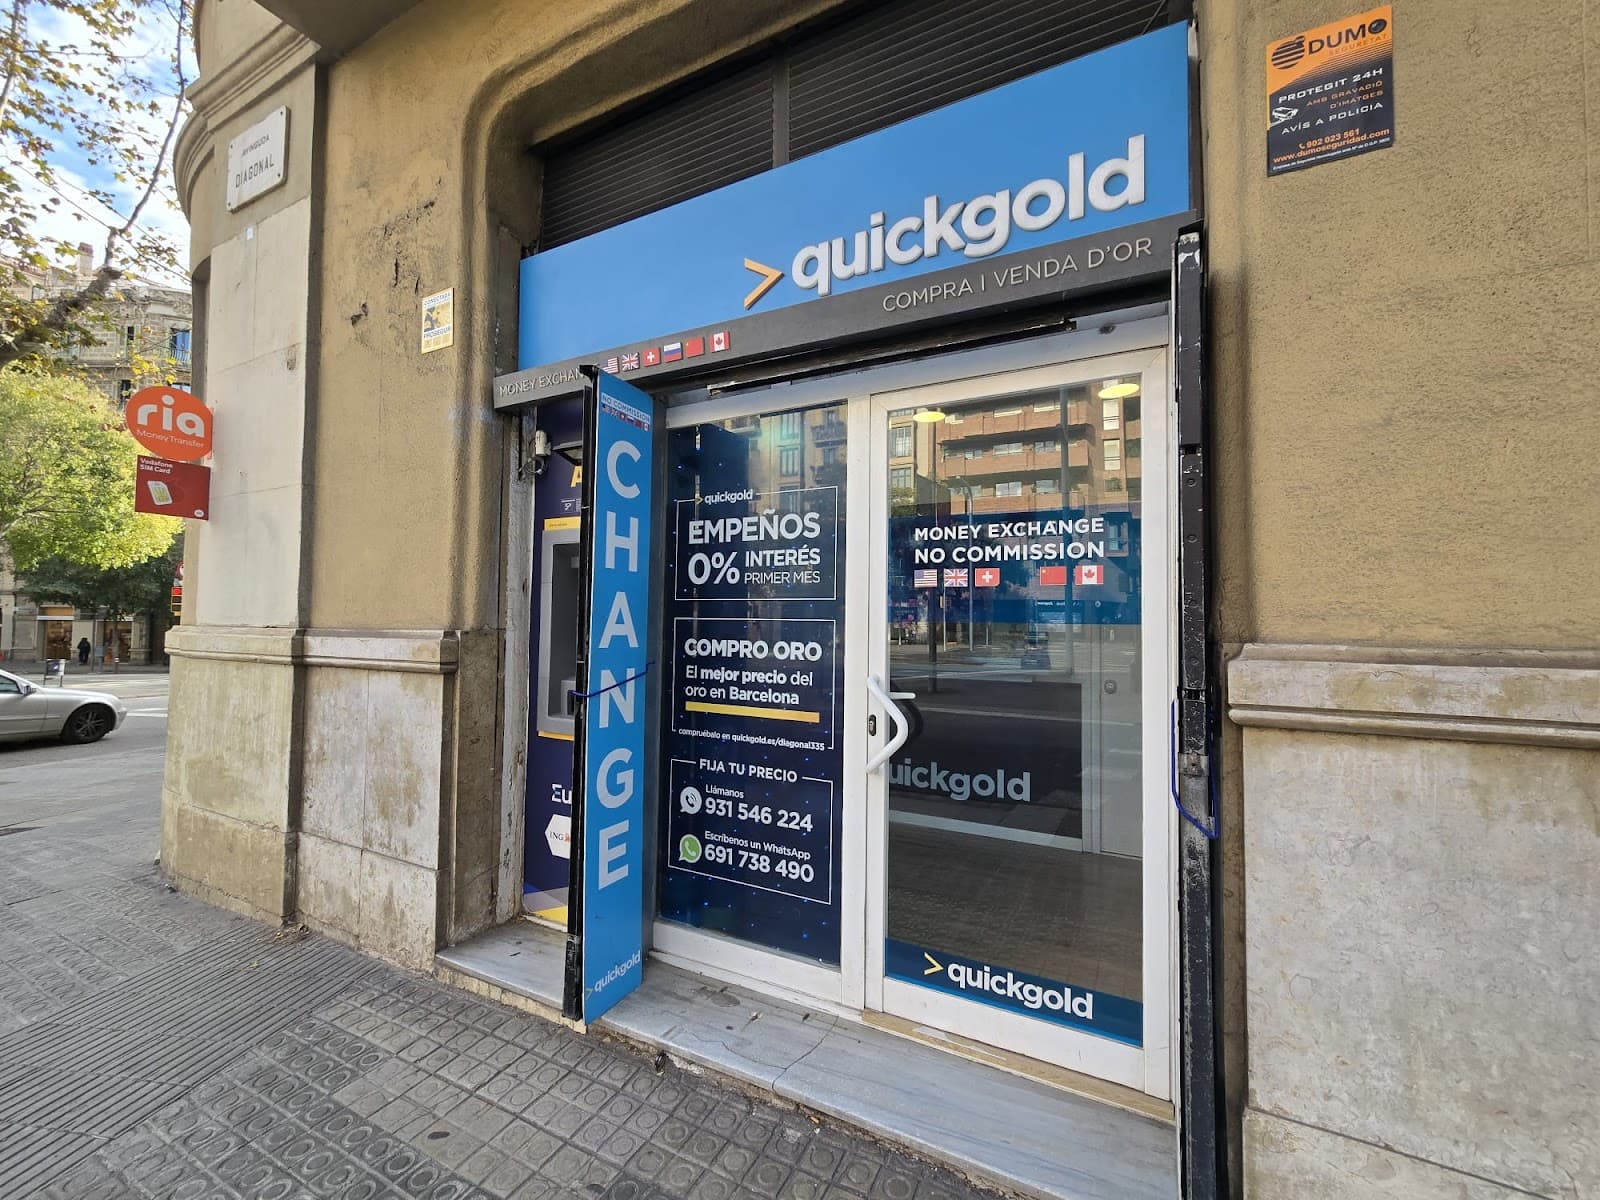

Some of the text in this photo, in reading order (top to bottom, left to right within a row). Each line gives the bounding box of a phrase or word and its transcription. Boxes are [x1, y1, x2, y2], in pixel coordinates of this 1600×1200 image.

[1308, 18, 1387, 55] DUMO
[1278, 67, 1383, 104] PROTEGIT 24H
[1306, 96, 1328, 107] AMB
[1315, 118, 1325, 126] A
[1328, 102, 1383, 121] POLICIA
[1273, 129, 1390, 163] www.dumoseguridad.com
[1306, 138, 1323, 148] 902
[1324, 134, 1341, 144] 023
[235, 153, 275, 188] DIAGONAL
[791, 133, 1146, 297] quickgold
[882, 278, 974, 313] COMPRA
[993, 254, 1078, 288] VENDA
[1087, 237, 1153, 269] D'OR
[499, 379, 538, 398] MONEY
[137, 394, 205, 438] ria
[602, 394, 650, 423] NO COMMISSION
[136, 429, 204, 448] Money Transfer
[140, 457, 173, 468] Vodafone
[140, 464, 171, 474] SIM Card
[704, 488, 753, 505] quickgold
[688, 509, 821, 545] EMPEÑOS
[914, 517, 1104, 541] MONEY EXCHANGE
[687, 544, 821, 585] 0% INTERÉS
[914, 541, 1104, 564] NO COMMISSION
[744, 571, 789, 585] PRIMER
[684, 638, 823, 661] COMPRO ORO
[597, 440, 642, 890] CHANGE
[685, 665, 813, 686] El mejor precio del
[685, 685, 800, 705] oro en Barcelona
[721, 732, 731, 740] en
[699, 758, 798, 783] FIJA TU PRECIO
[705, 784, 744, 799] Llámanos
[705, 797, 814, 833] 931 546 224
[549, 831, 564, 841] ING
[750, 840, 761, 850] un
[763, 842, 811, 861] WhatsApp
[704, 844, 815, 883] 691 738 490
[594, 949, 641, 993] quickgold
[947, 962, 1093, 1020] quickgold
